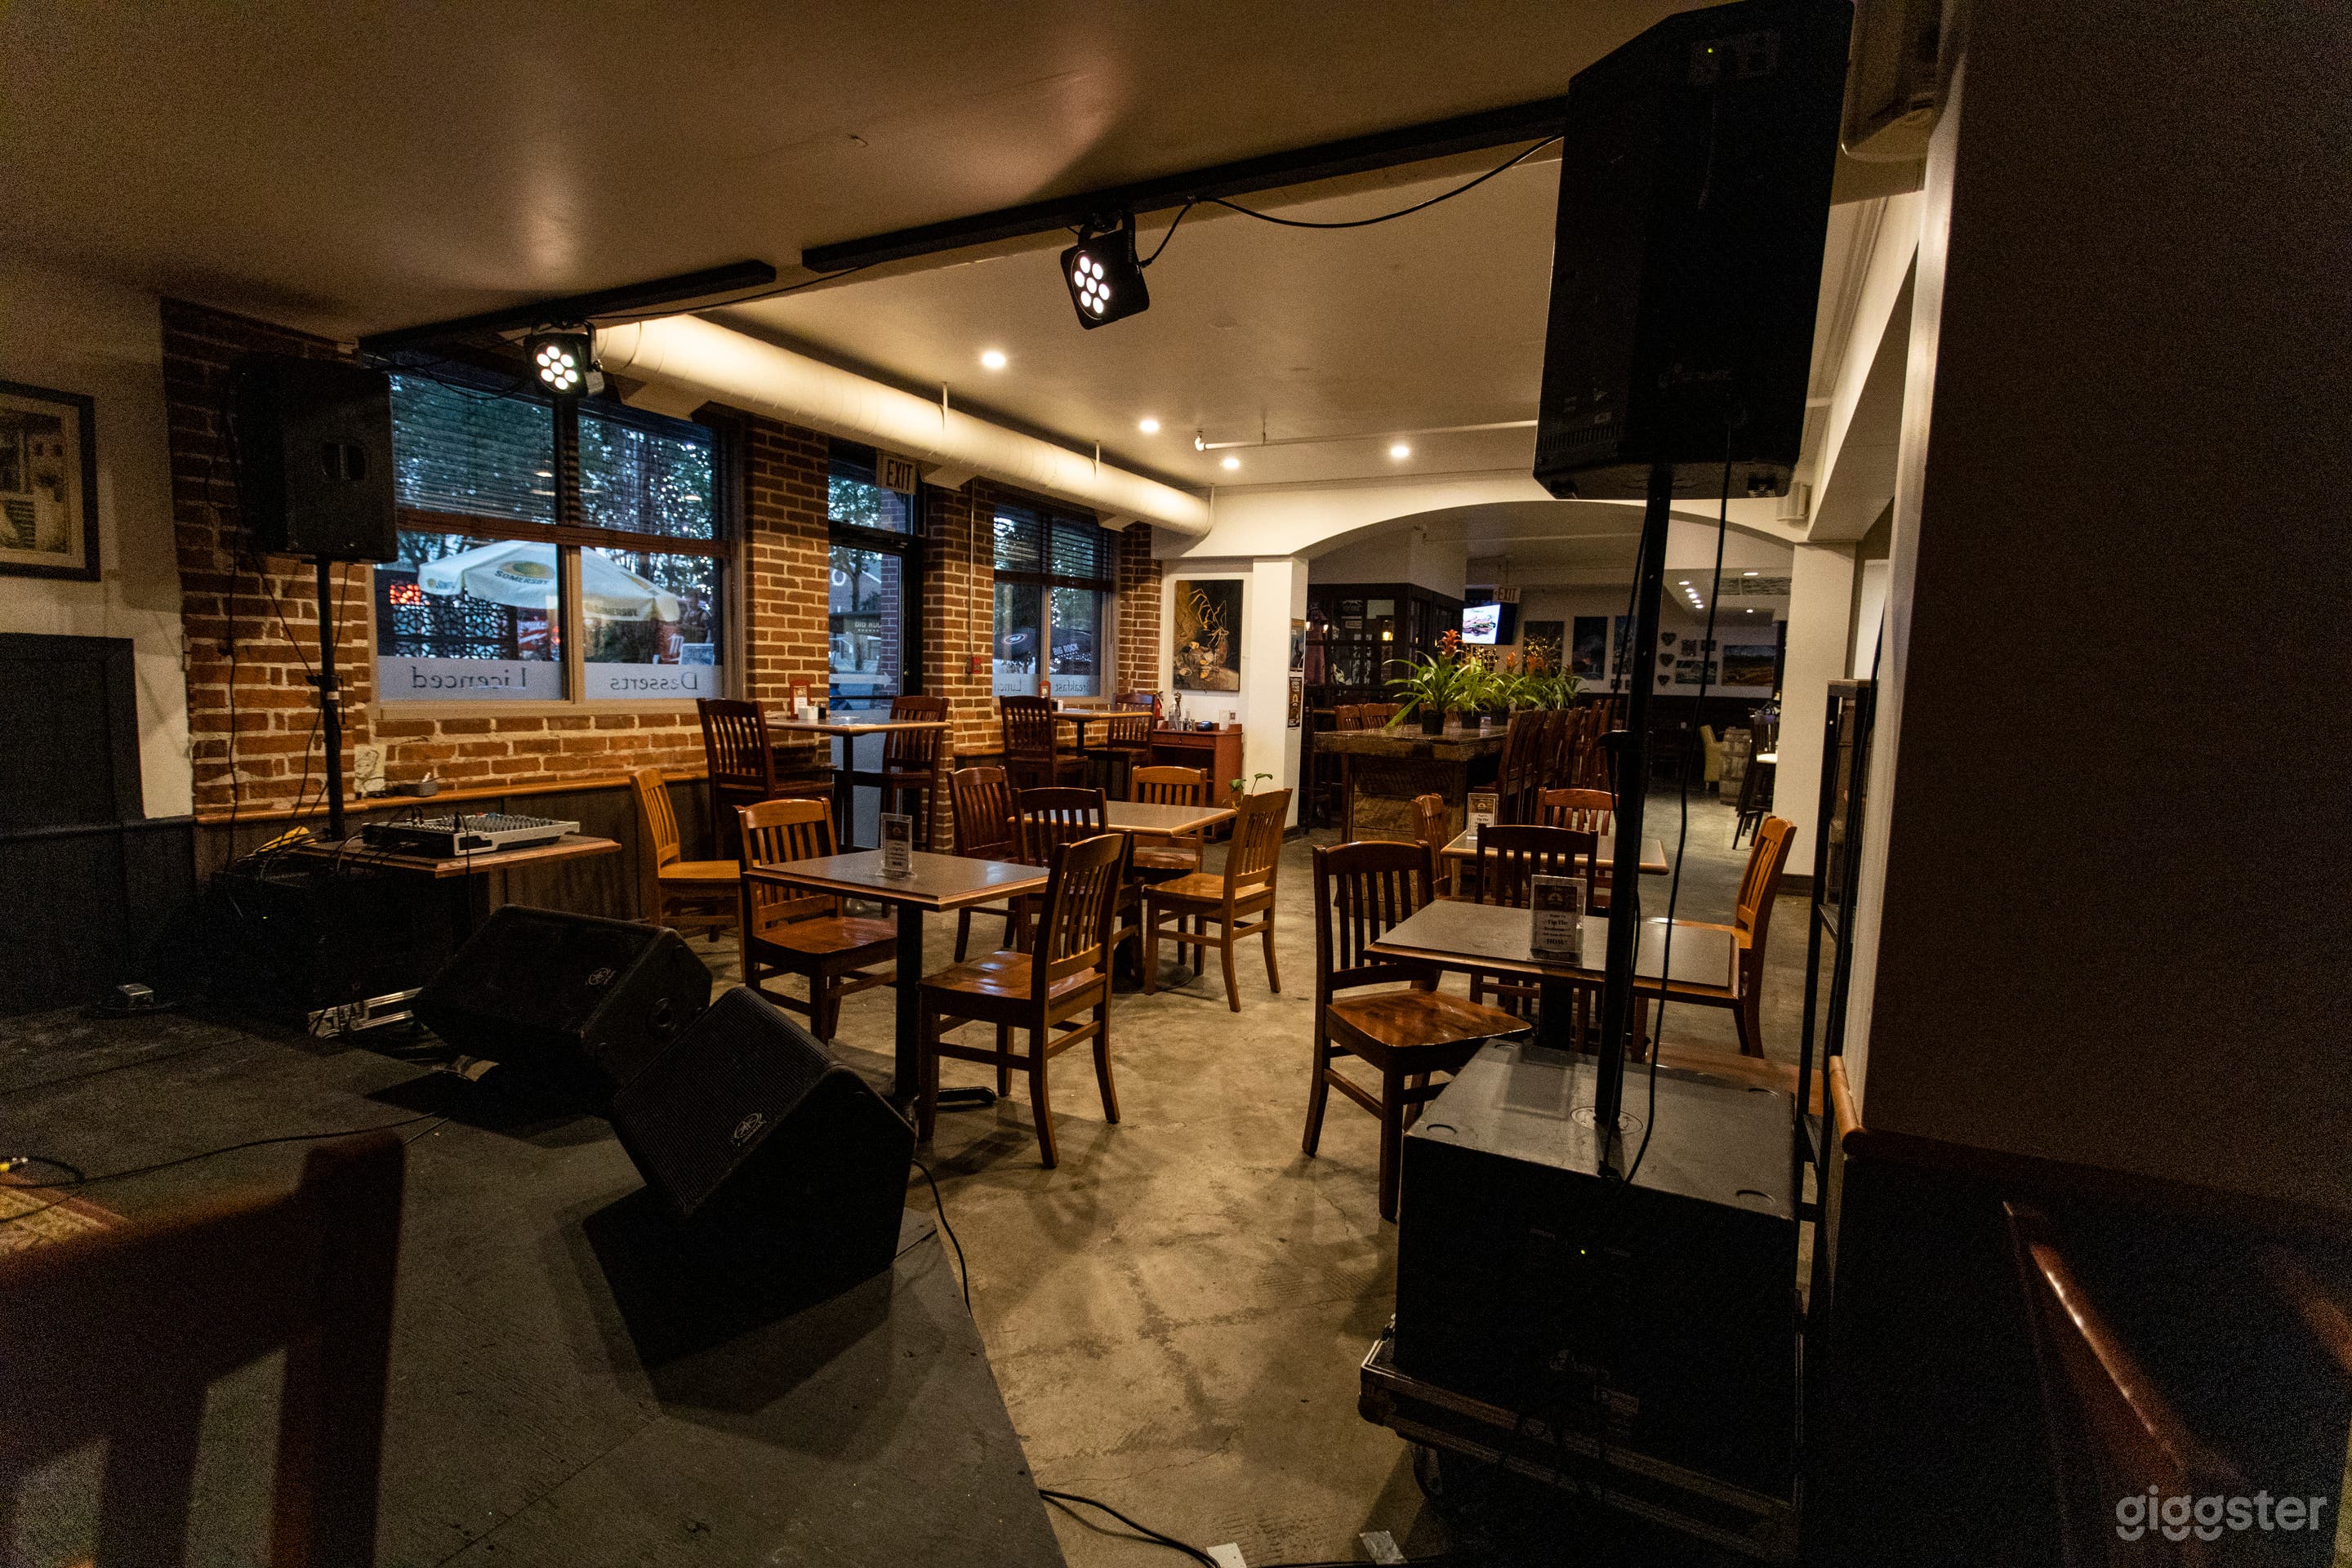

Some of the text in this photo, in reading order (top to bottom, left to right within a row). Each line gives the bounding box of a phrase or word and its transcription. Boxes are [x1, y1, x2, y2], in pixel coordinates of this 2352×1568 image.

[886, 459, 913, 491] EXIT
[494, 570, 549, 585] SOMERSBY
[1497, 587, 1517, 602] EXIT
[595, 606, 639, 617] OMERSBY
[1053, 646, 1063, 656] BIG
[1063, 644, 1079, 653] ROCK
